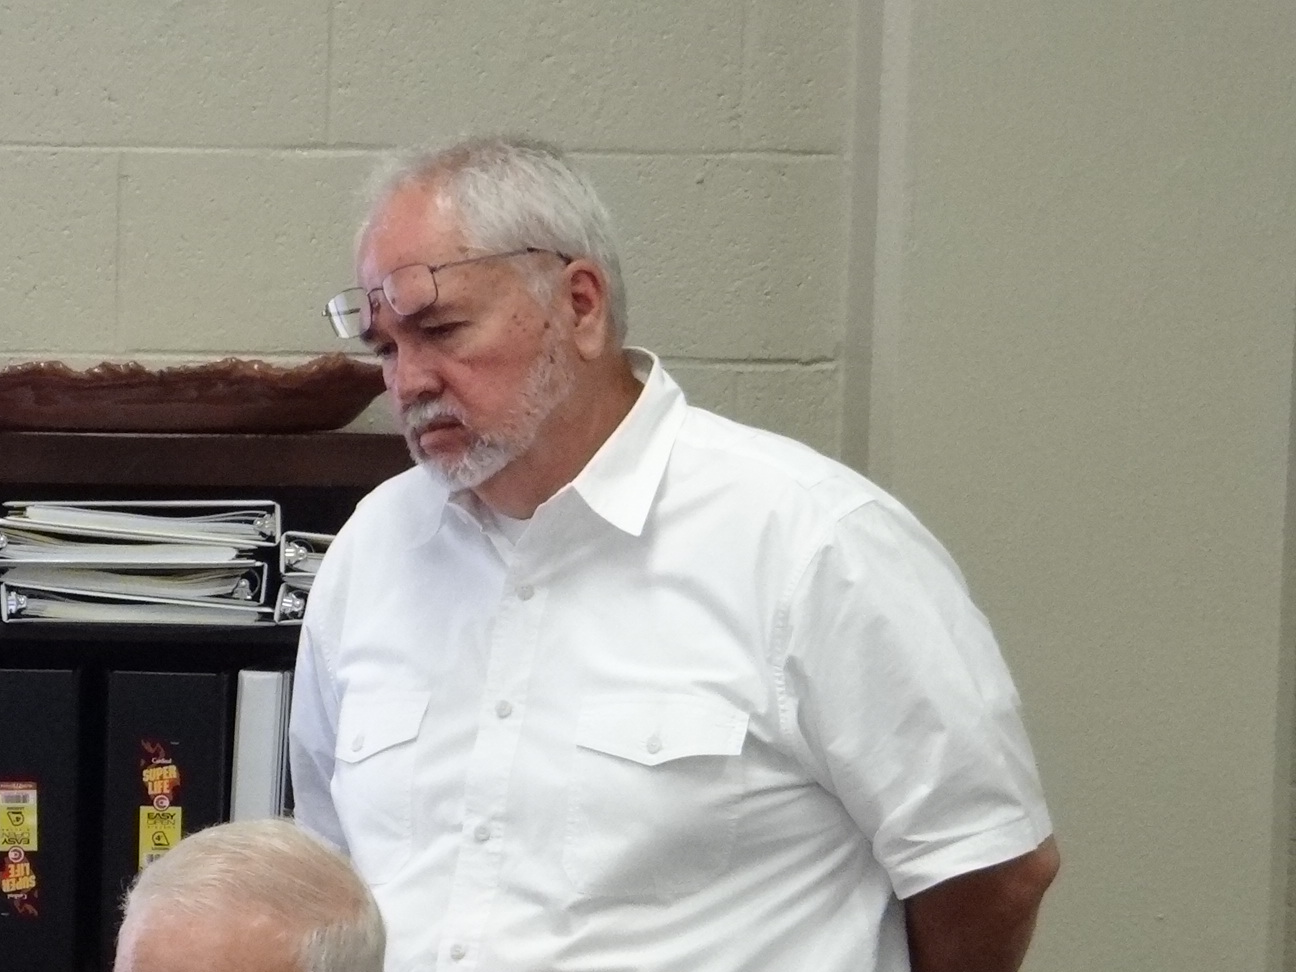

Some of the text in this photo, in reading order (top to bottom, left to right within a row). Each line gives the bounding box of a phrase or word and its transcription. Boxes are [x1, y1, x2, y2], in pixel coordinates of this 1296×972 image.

[142, 764, 177, 782] SUPER
[148, 779, 170, 795] LIFE
[8, 862, 30, 878] LIFE
[1, 875, 36, 893] SUPER
